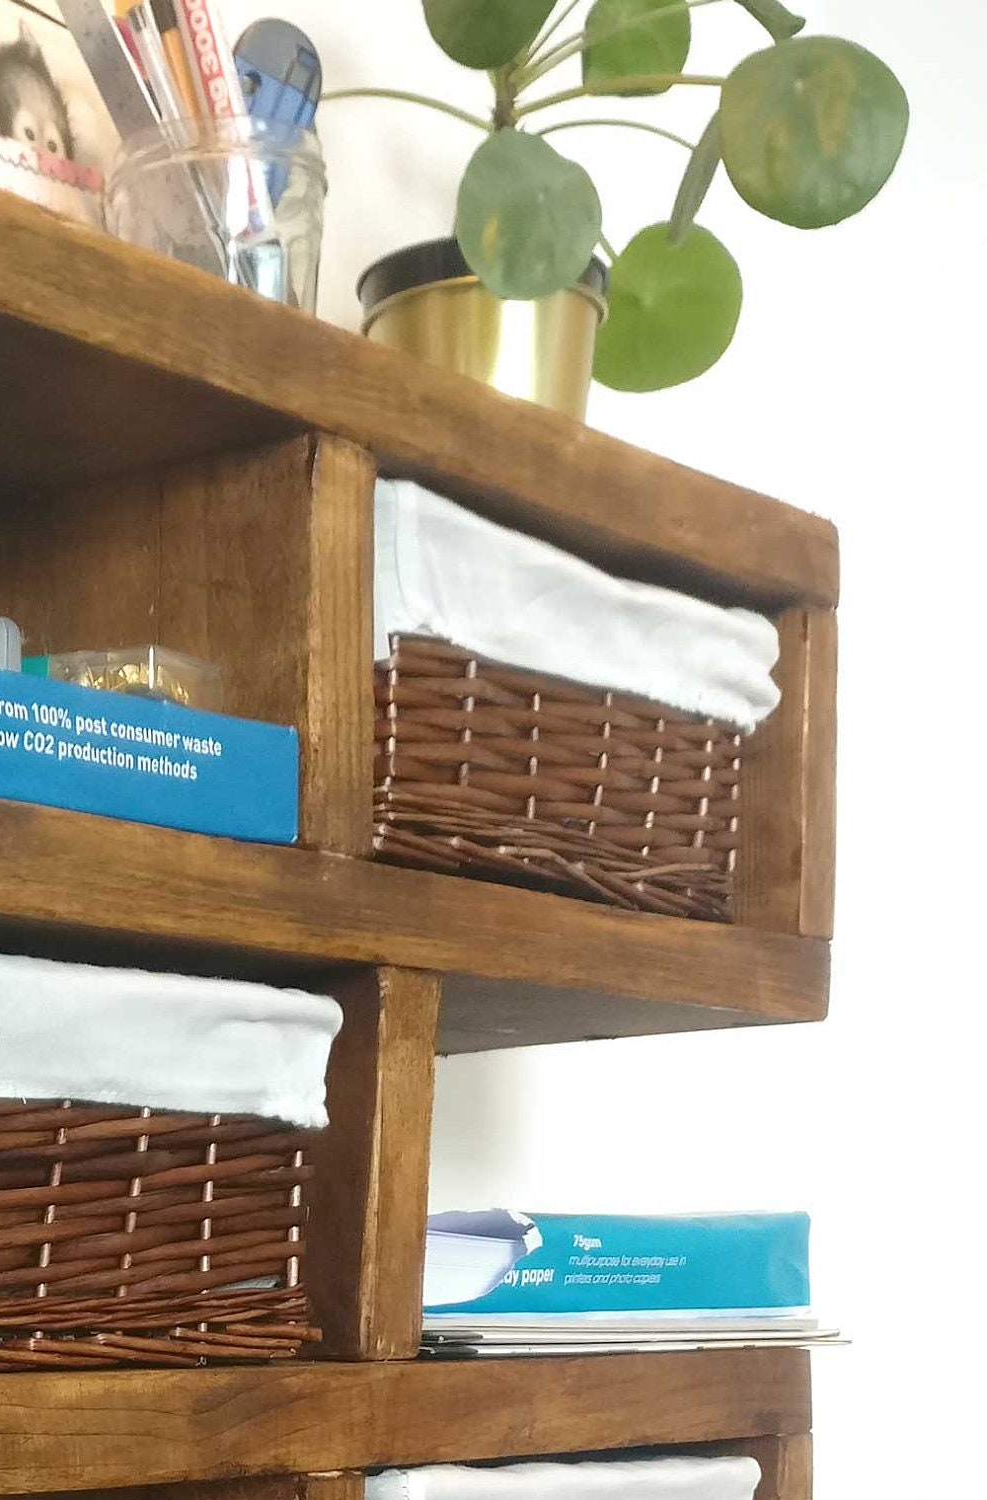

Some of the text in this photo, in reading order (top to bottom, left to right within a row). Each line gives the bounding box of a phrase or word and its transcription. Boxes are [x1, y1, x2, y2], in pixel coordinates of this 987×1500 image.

[31, 703, 72, 730] 100%
[75, 714, 108, 737] post
[110, 720, 180, 748] consumer
[182, 736, 222, 757] waste
[23, 730, 54, 755] CO2
[58, 740, 134, 771] production
[138, 751, 198, 780] methods
[572, 1234, 602, 1251] 75gsm
[521, 1268, 554, 1286] paper
[593, 1273, 610, 1284] and
